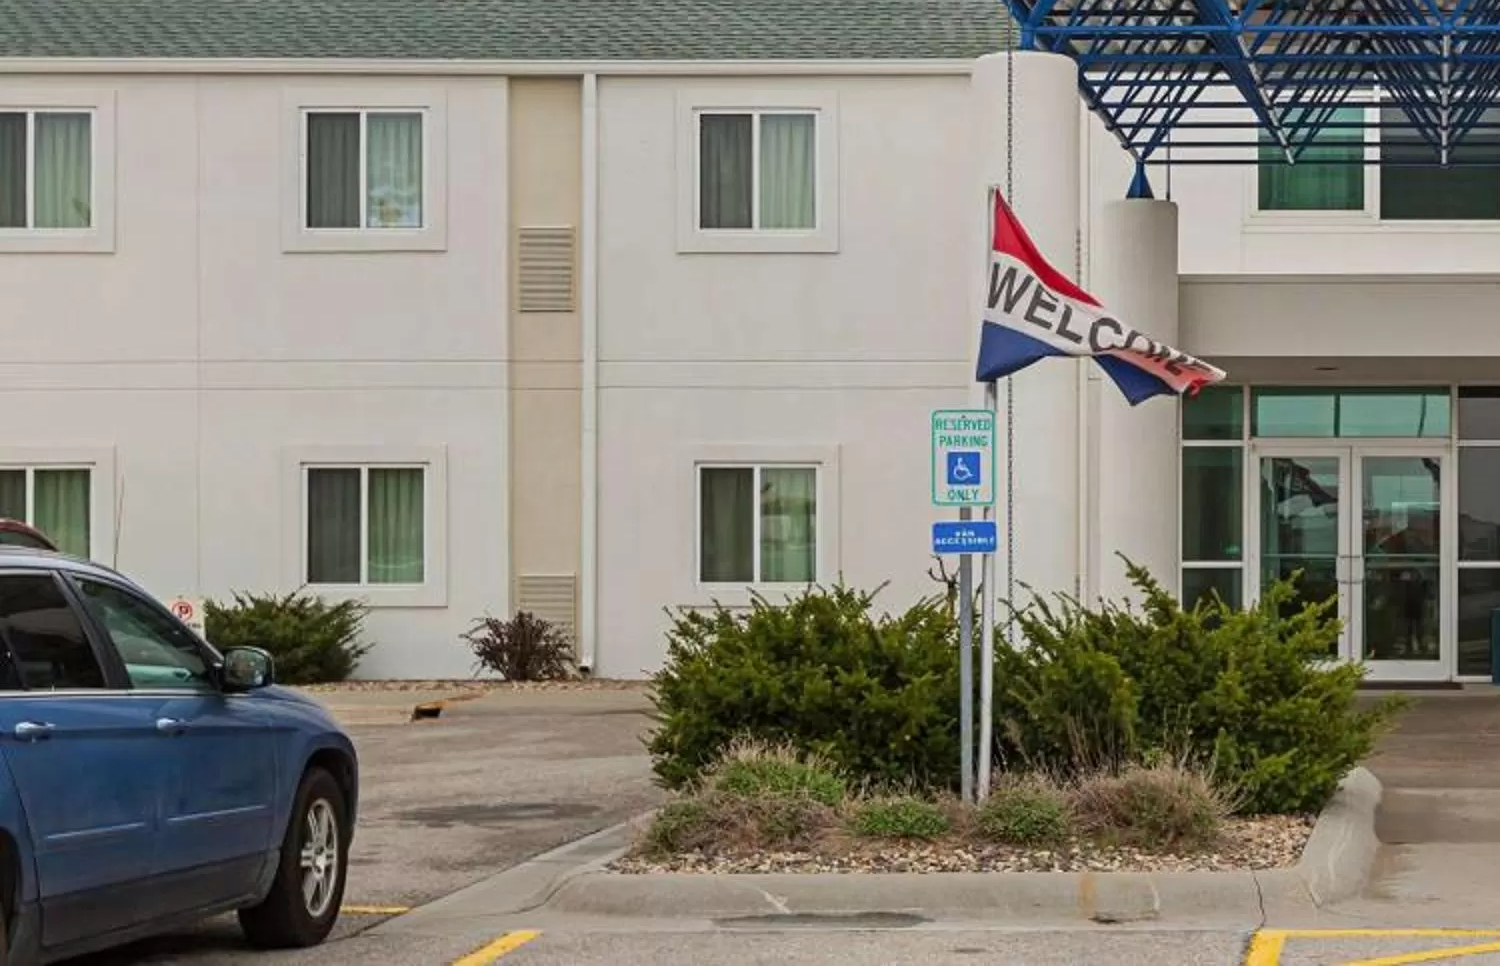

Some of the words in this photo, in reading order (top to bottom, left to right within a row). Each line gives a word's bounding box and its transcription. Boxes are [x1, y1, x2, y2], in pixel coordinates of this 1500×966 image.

[934, 418, 992, 430] RESERVED
[939, 435, 988, 446] PARKING
[948, 489, 978, 501] ONLY
